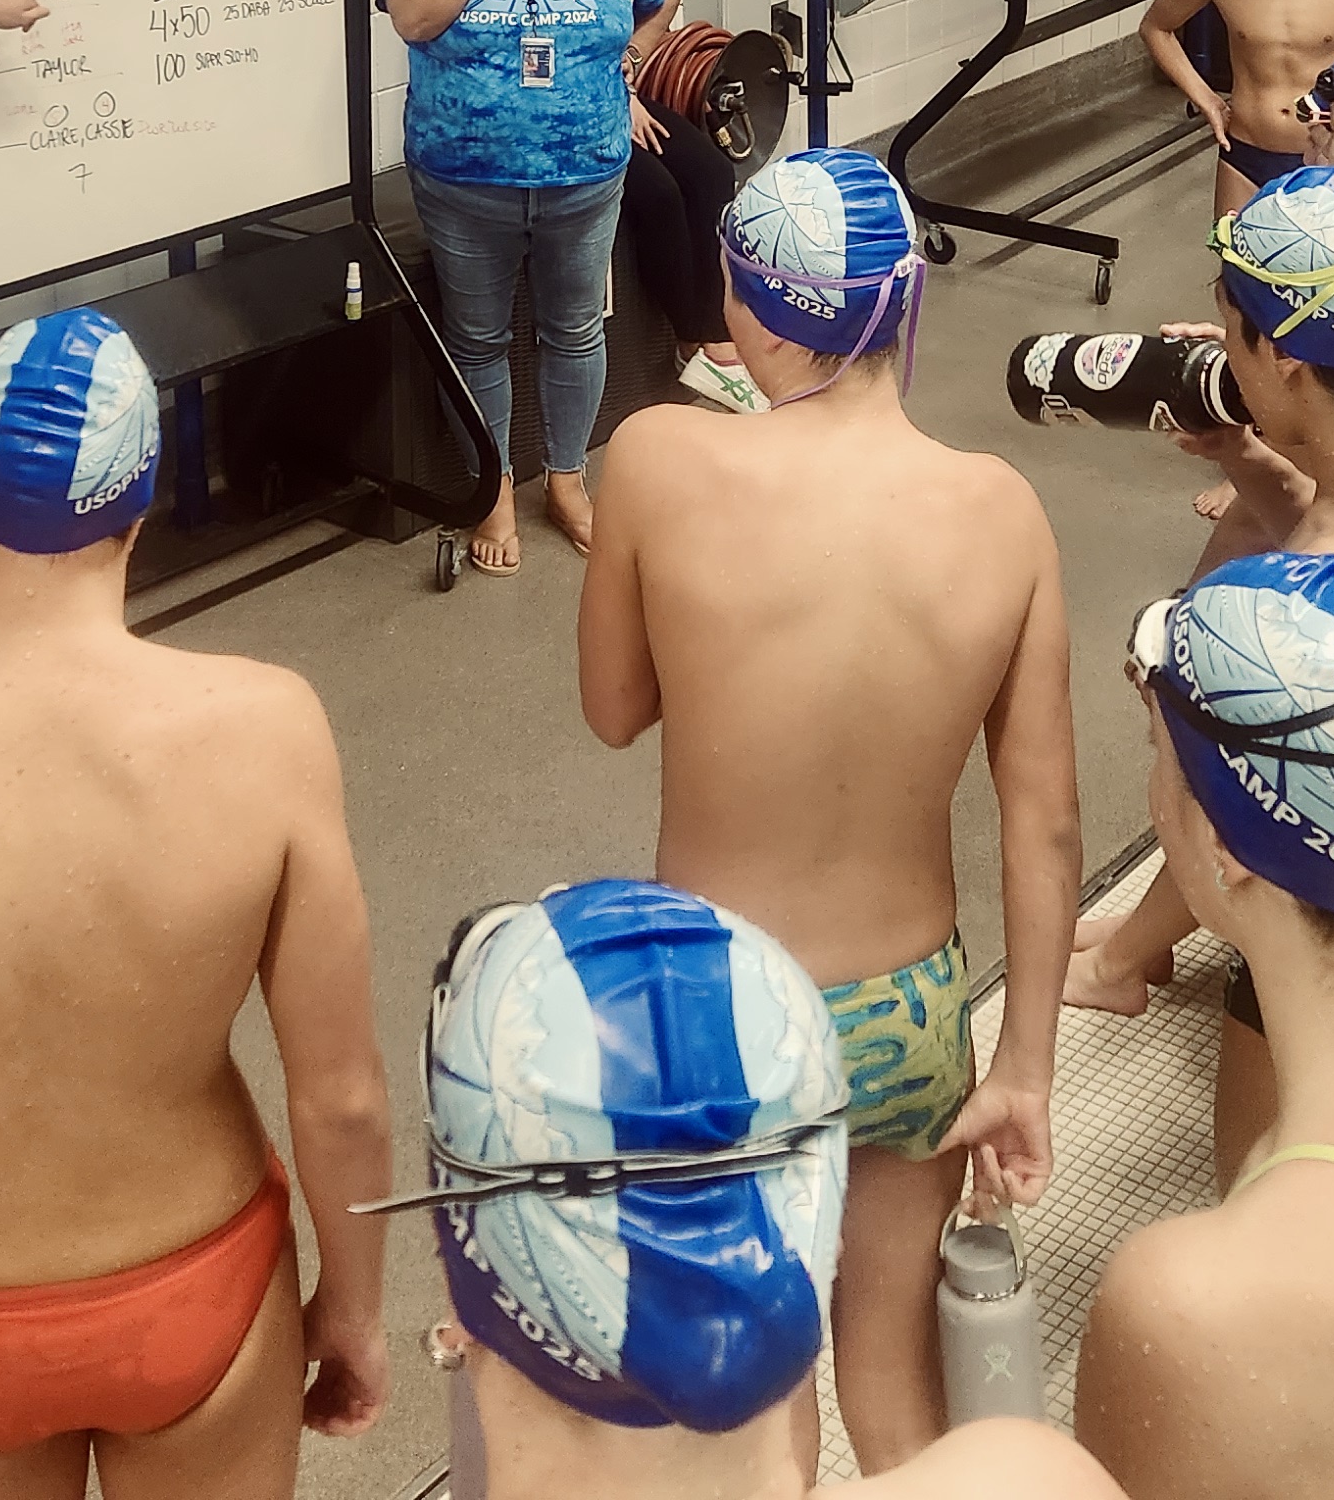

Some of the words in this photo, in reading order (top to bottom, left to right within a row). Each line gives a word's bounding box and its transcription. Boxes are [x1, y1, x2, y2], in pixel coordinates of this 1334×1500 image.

[223, 4, 239, 21] 25
[459, 11, 518, 26] USOPTC
[521, 12, 561, 27] CAMP
[564, 10, 597, 24] 2024
[31, 55, 92, 82] TAYLOR
[156, 54, 186, 85] 100
[68, 163, 93, 194] 7
[783, 288, 836, 320] 2025
[1217, 742, 1301, 829] CAMP
[490, 1290, 605, 1384] 2025
